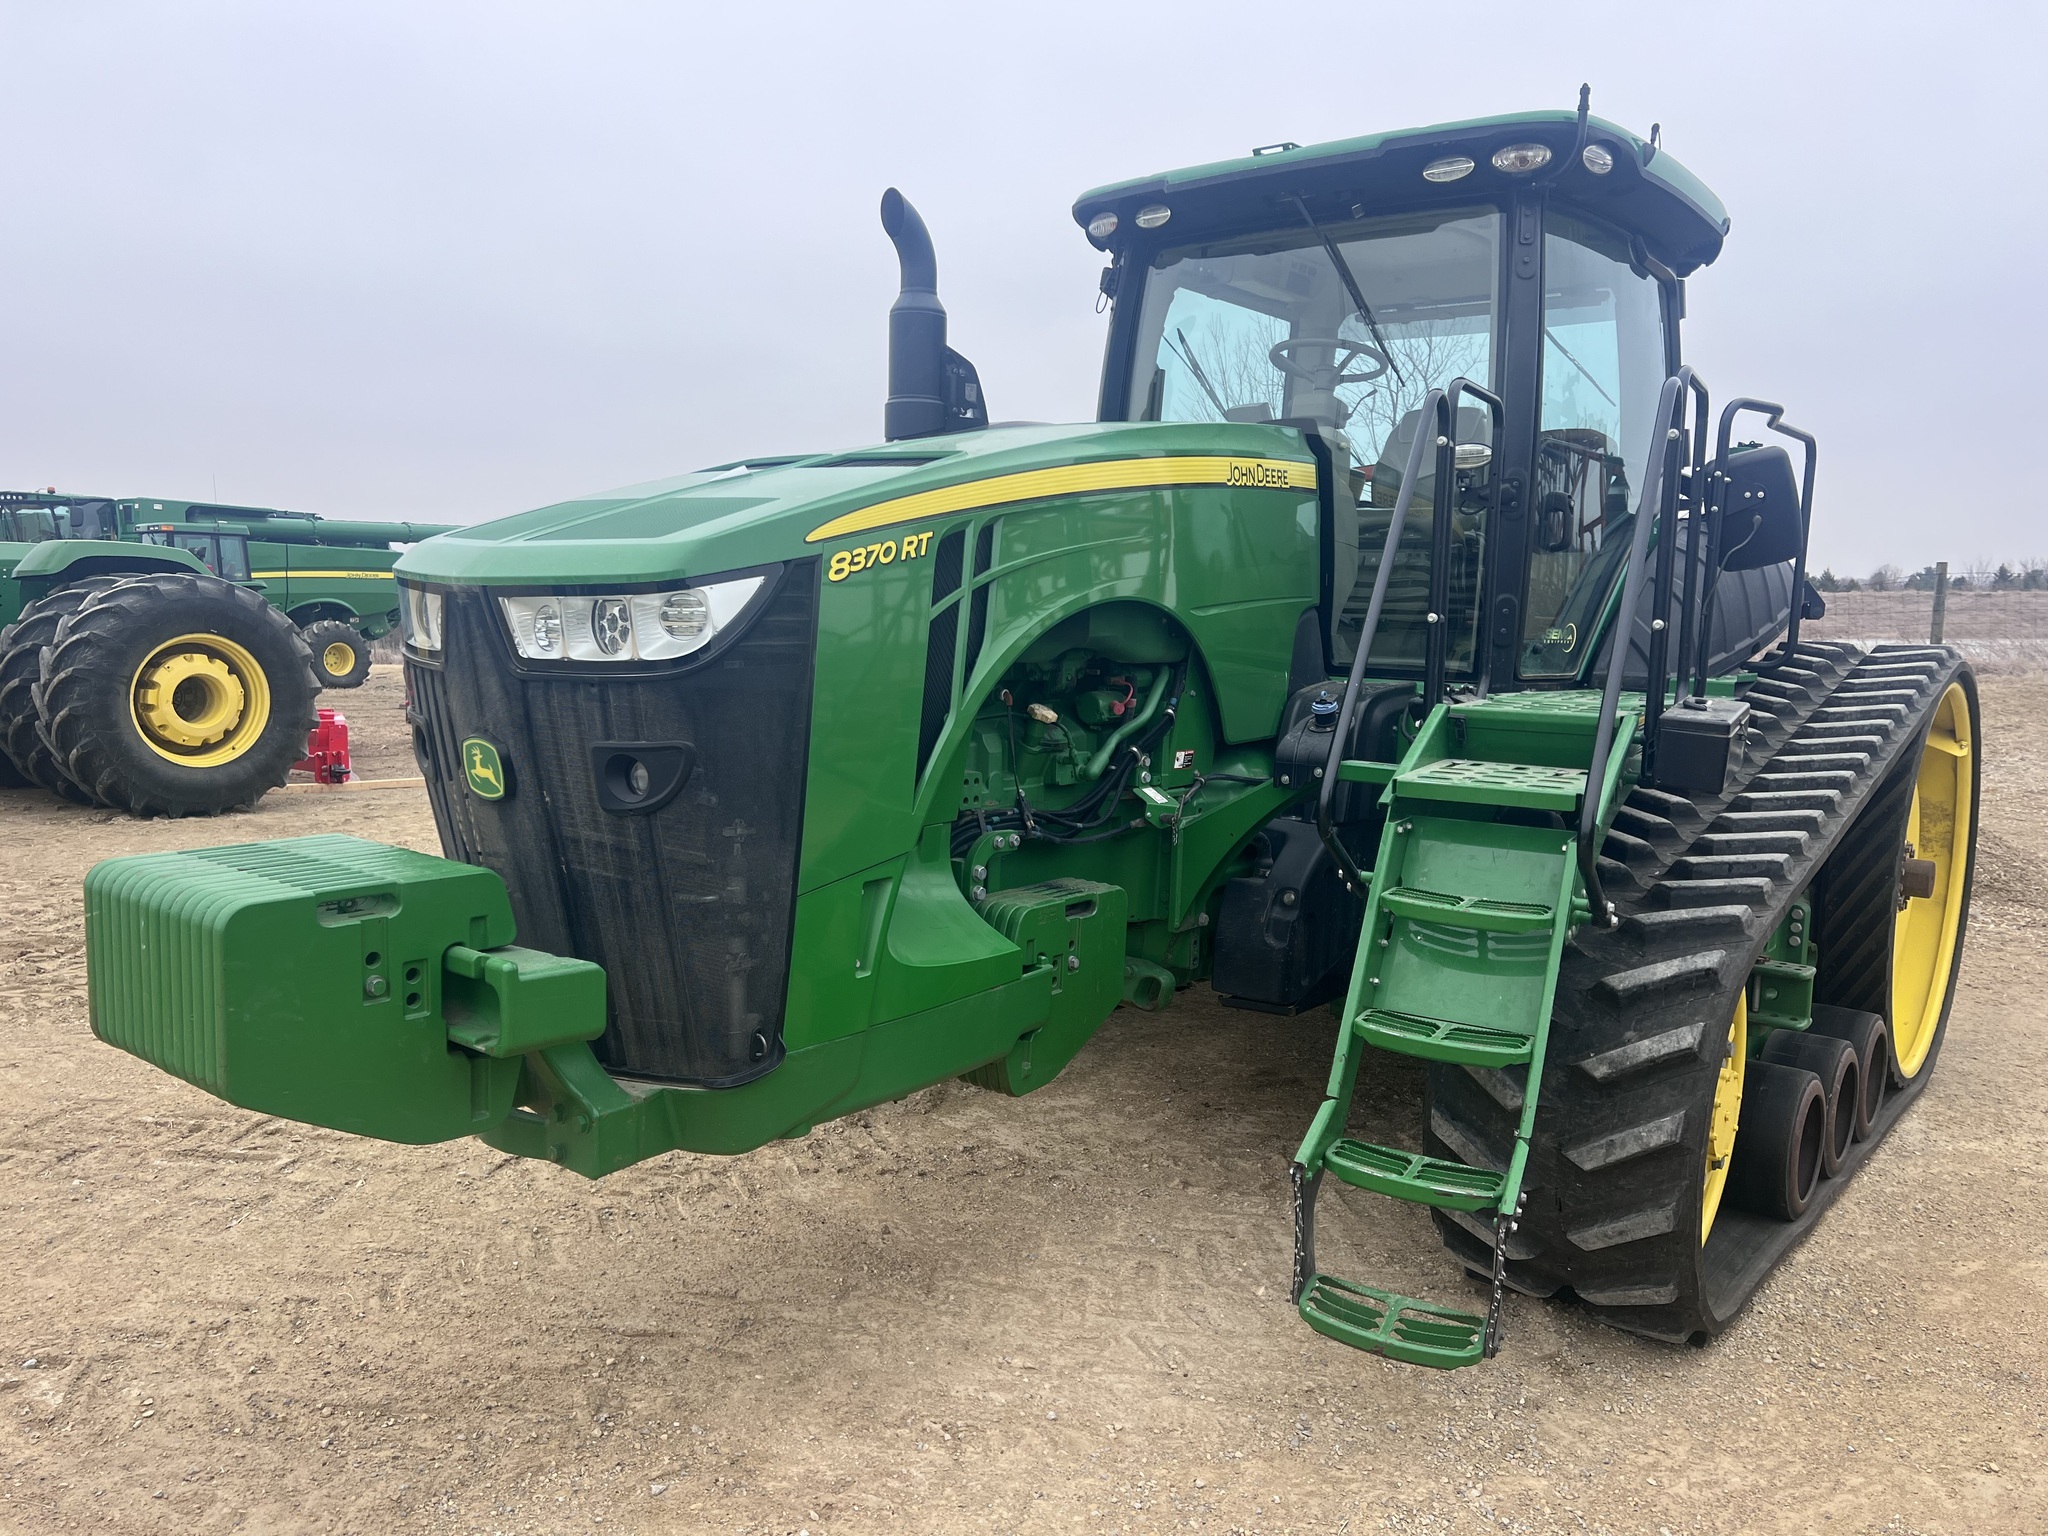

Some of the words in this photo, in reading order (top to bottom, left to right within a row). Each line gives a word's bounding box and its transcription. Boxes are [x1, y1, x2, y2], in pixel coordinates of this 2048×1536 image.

[1227, 462, 1256, 484] JOHN
[1257, 464, 1289, 486] DEERE
[828, 540, 897, 582] 8370
[901, 531, 934, 561] RT
